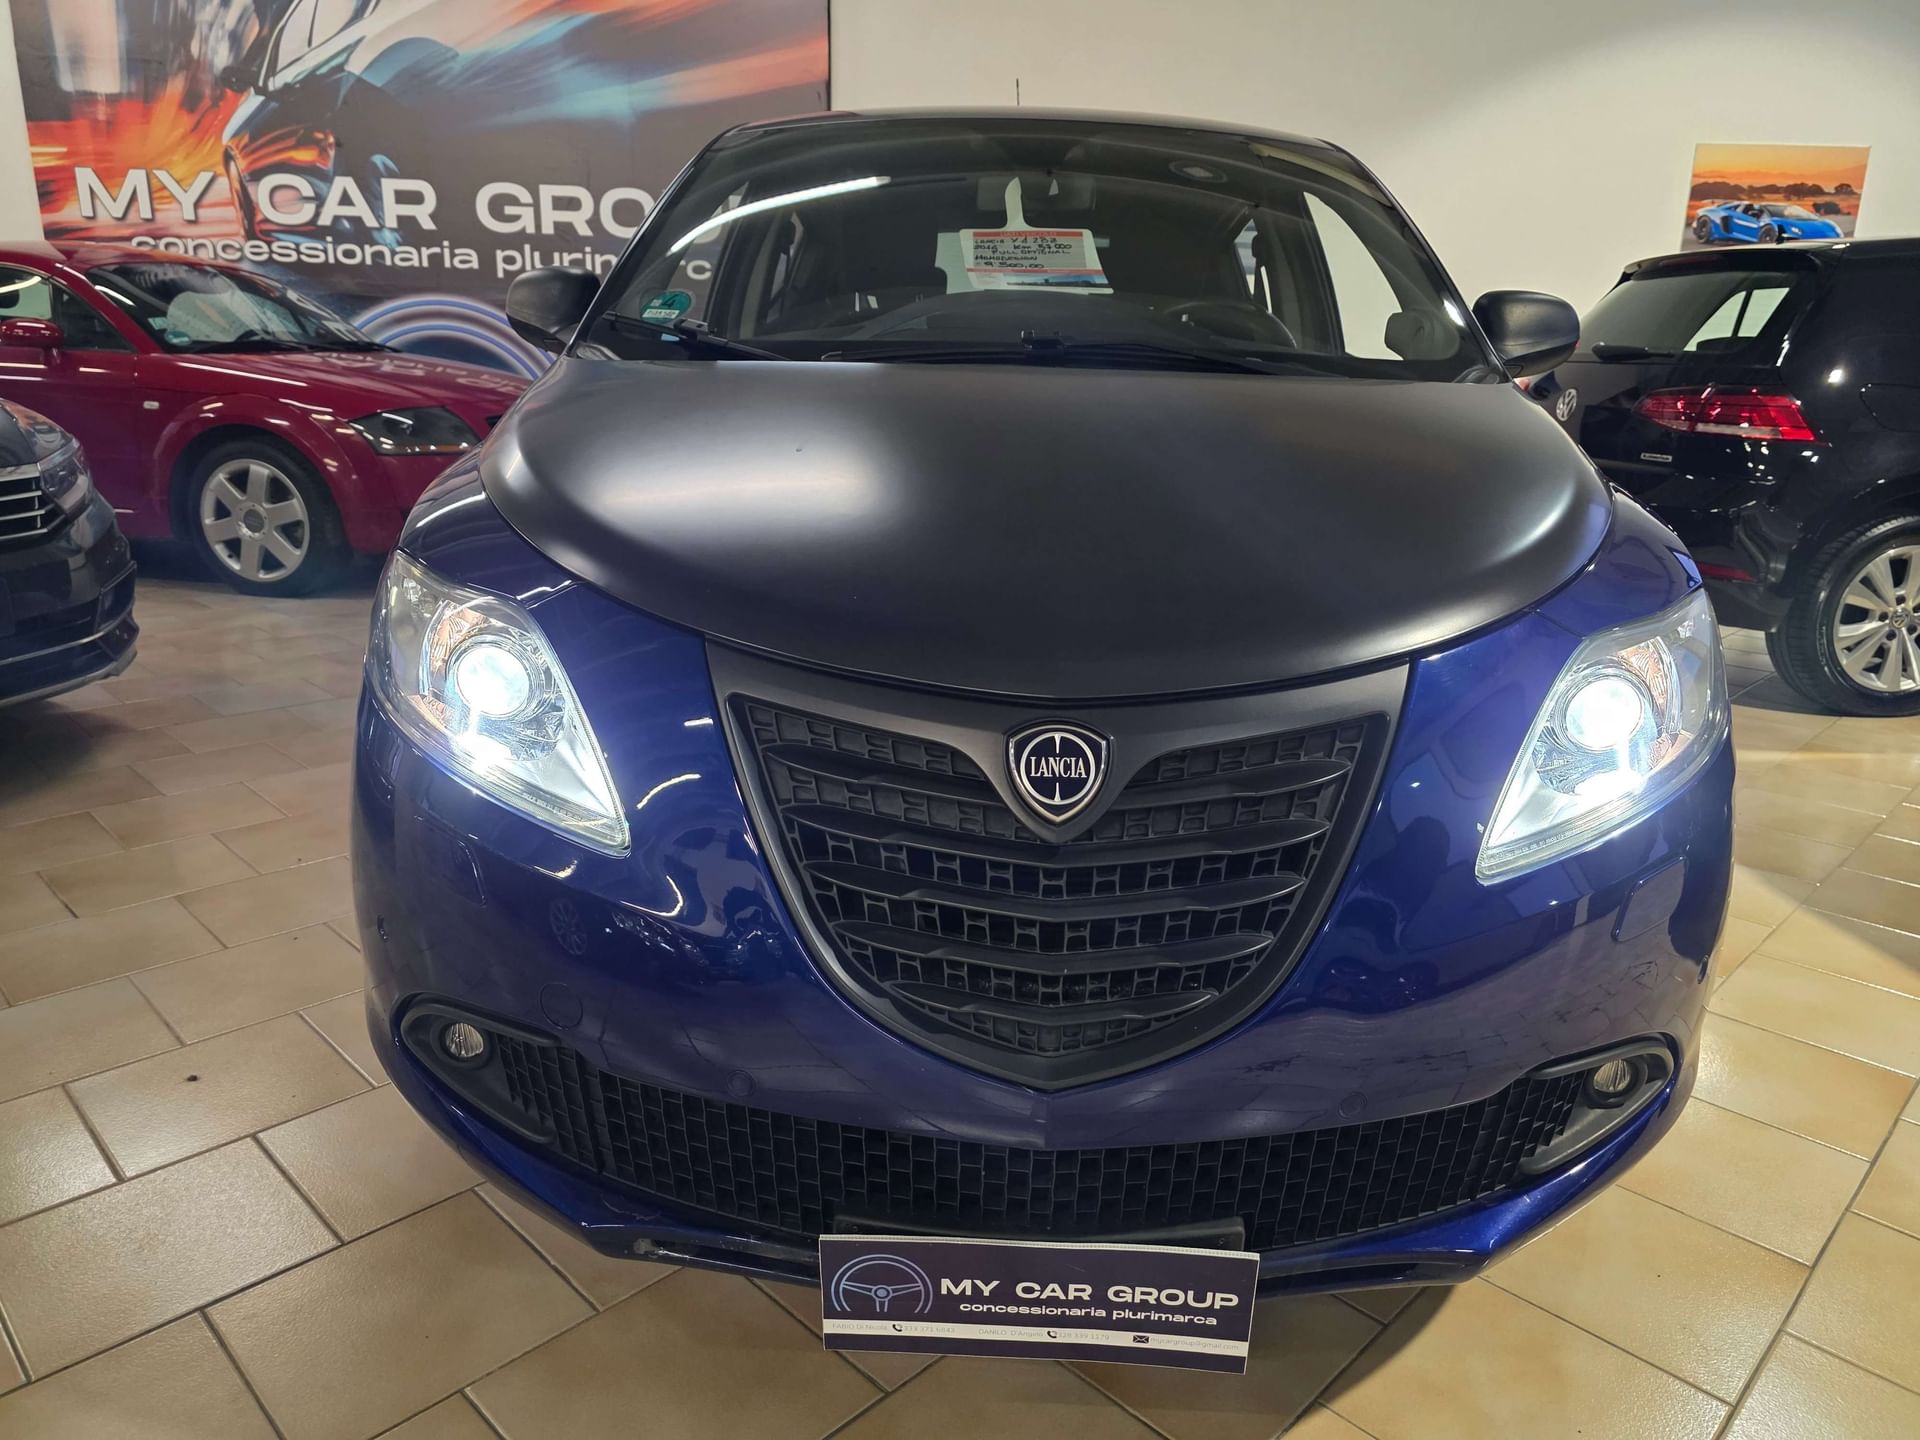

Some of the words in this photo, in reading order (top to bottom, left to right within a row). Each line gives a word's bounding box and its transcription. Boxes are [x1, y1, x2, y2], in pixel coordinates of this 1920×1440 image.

[74, 166, 216, 221] MY
[257, 172, 437, 230] CAR
[1029, 756, 1087, 778] LANCIA
[940, 1278, 1000, 1297] MY
[1015, 1281, 1093, 1301] CAR
[1106, 1285, 1239, 1310] GROUP
[959, 1302, 1106, 1318] concessionaria
[1112, 1308, 1217, 1326] plurimarca
